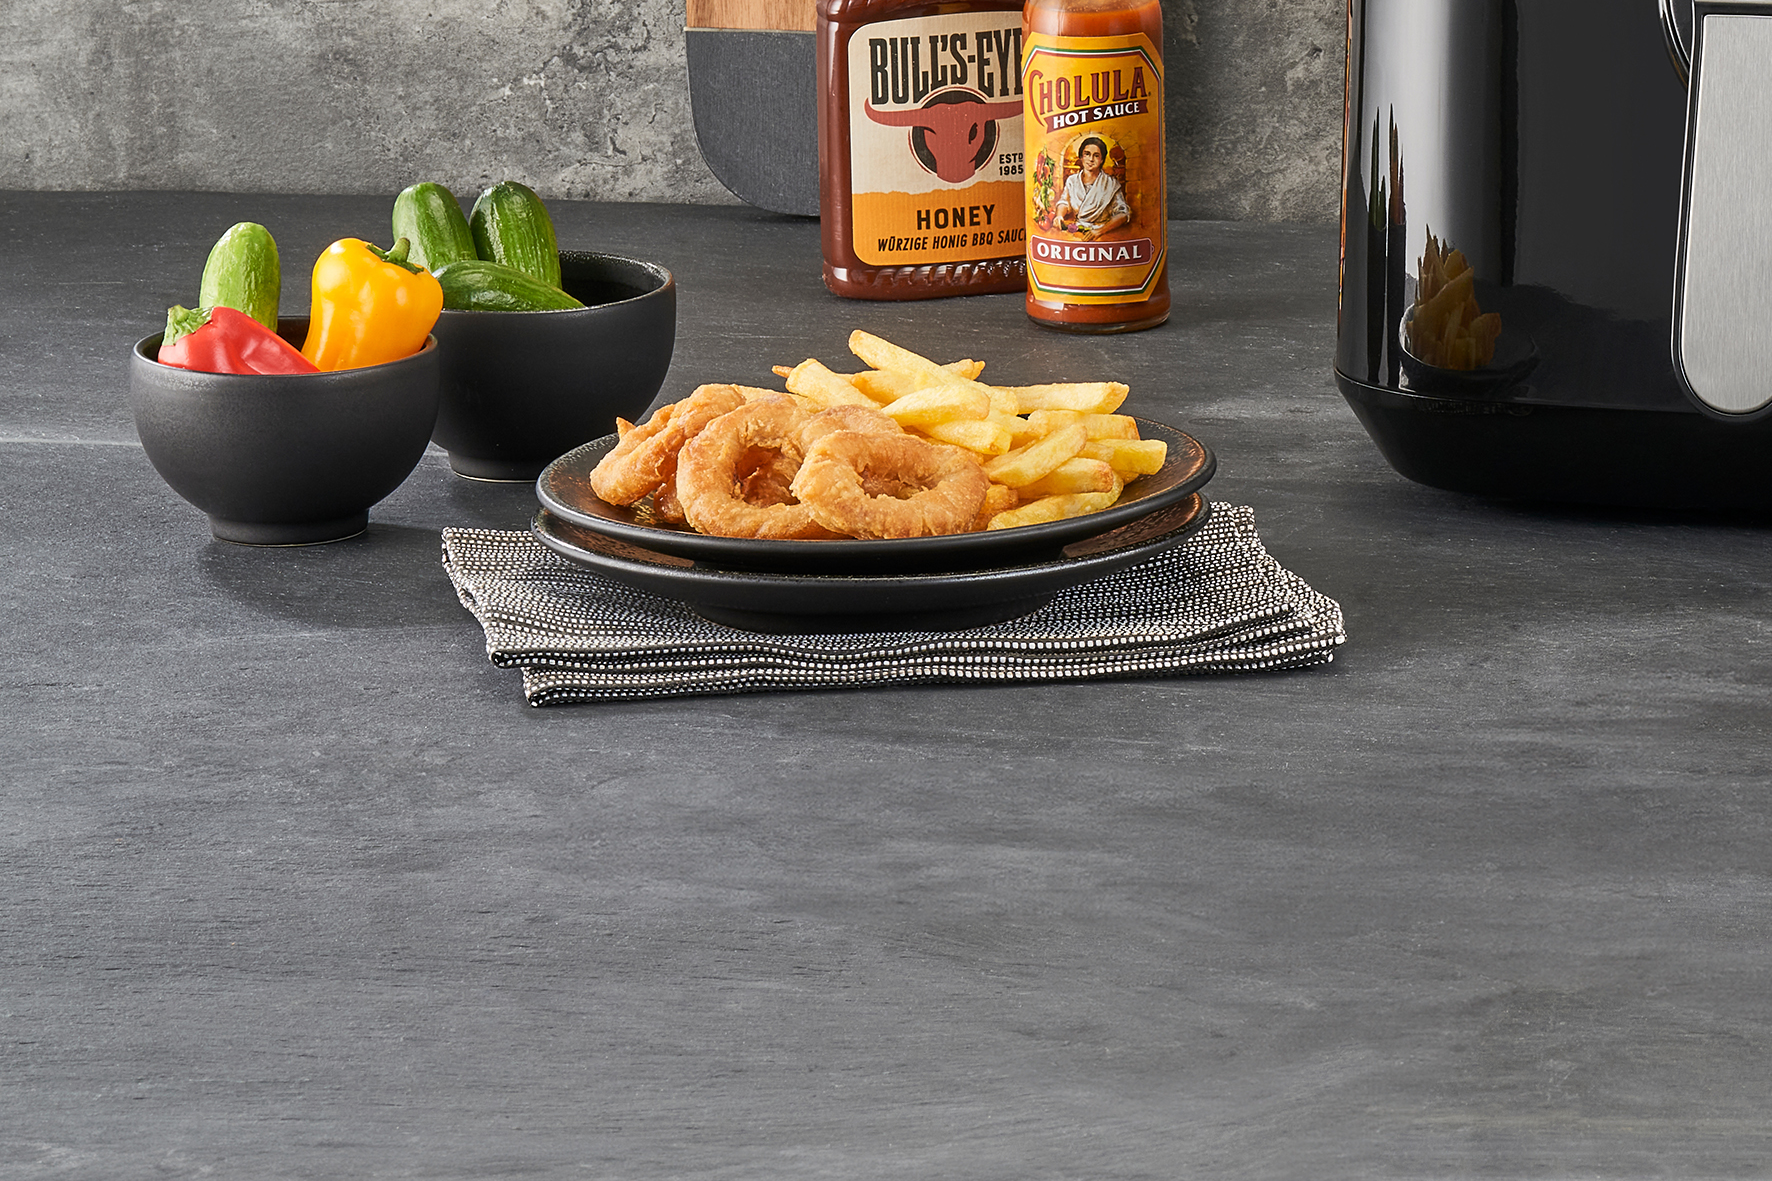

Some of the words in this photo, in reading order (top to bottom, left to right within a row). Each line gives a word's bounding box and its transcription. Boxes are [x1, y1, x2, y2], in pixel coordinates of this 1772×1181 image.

[1028, 66, 1148, 127] CHOLULA
[1053, 110, 1089, 129] HOT
[1093, 101, 1140, 120] SAUCE
[999, 164, 1024, 176] 1985
[916, 204, 995, 230] HONEY
[878, 236, 928, 252] WÜRZIGE
[932, 234, 968, 249] HONIG
[972, 231, 994, 247] BBQ
[997, 228, 1026, 244] SAUC
[1036, 242, 1142, 262] ORIGINAL
